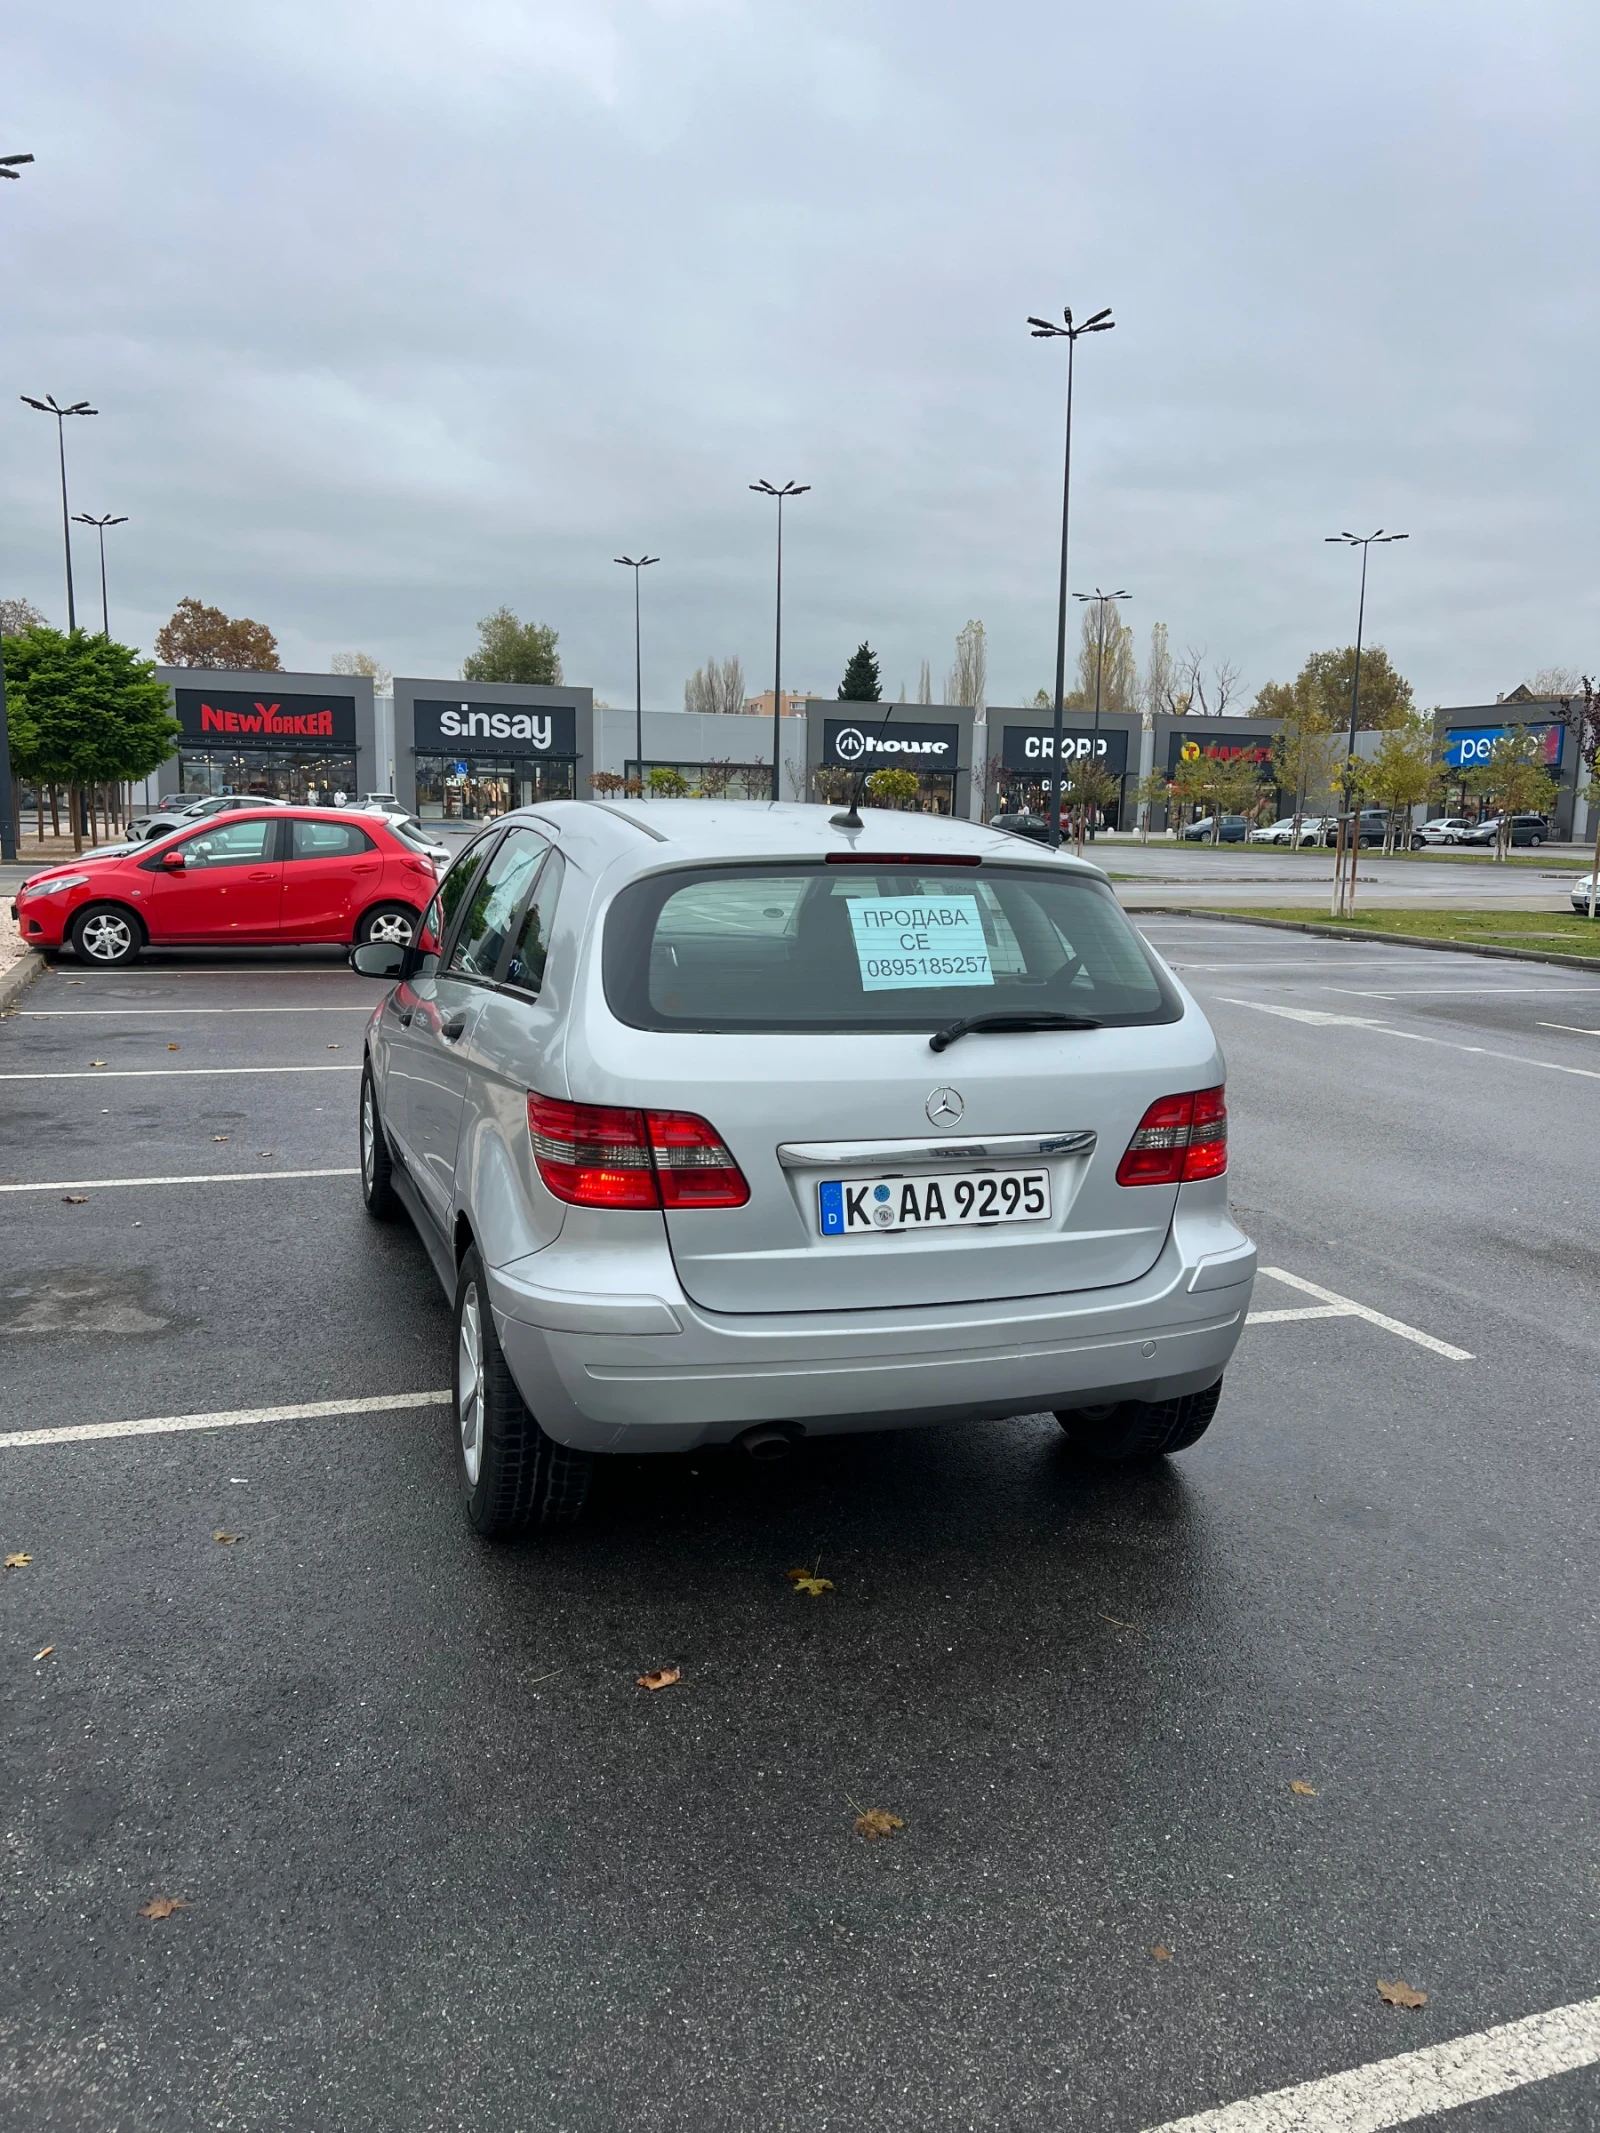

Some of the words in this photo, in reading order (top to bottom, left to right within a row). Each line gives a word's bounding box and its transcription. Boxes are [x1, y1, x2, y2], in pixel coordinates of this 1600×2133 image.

[439, 704, 552, 750] sinsay
[866, 737, 949, 754] house
[1025, 737, 1107, 759] CROPP
[863, 909, 969, 929] ПРОДАВА
[900, 933, 931, 951] СЕ
[867, 956, 988, 978] 0895185257
[828, 1213, 837, 1225] D
